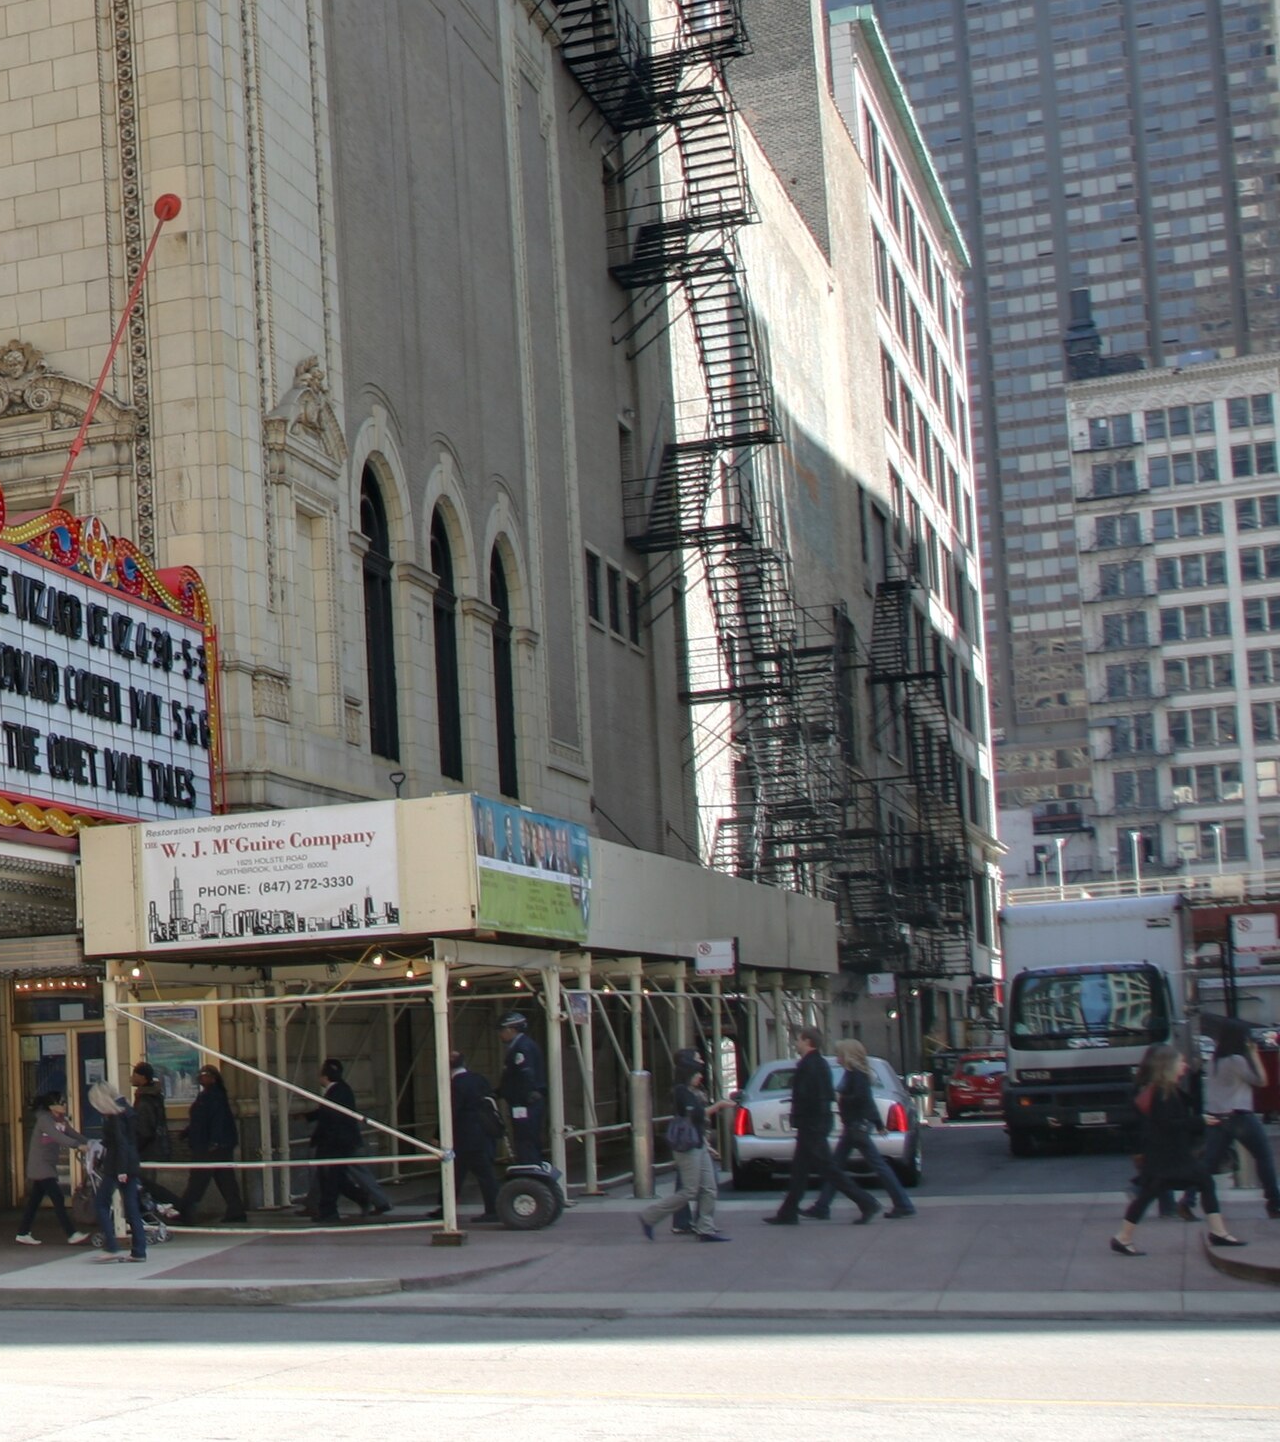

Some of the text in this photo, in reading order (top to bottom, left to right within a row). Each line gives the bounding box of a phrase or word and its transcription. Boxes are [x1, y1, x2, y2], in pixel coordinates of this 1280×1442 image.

[12, 571, 82, 639] WIZARD
[87, 602, 109, 648] OF
[112, 612, 134, 660] OZ
[64, 665, 122, 724] COHEN
[129, 686, 162, 735] MAY
[3, 720, 197, 809] THE QUIET MAN TALES
[145, 819, 286, 838] Restoration being performed by:
[160, 841, 187, 859] W.
[191, 839, 207, 857] J.
[212, 835, 285, 855] McGuire
[289, 830, 377, 848] Company
[254, 856, 284, 865] HOLSTE
[286, 854, 308, 862] ROAD
[272, 862, 304, 872] ILLINOIS
[198, 874, 354, 898] PHONE: (847) 272-3330
